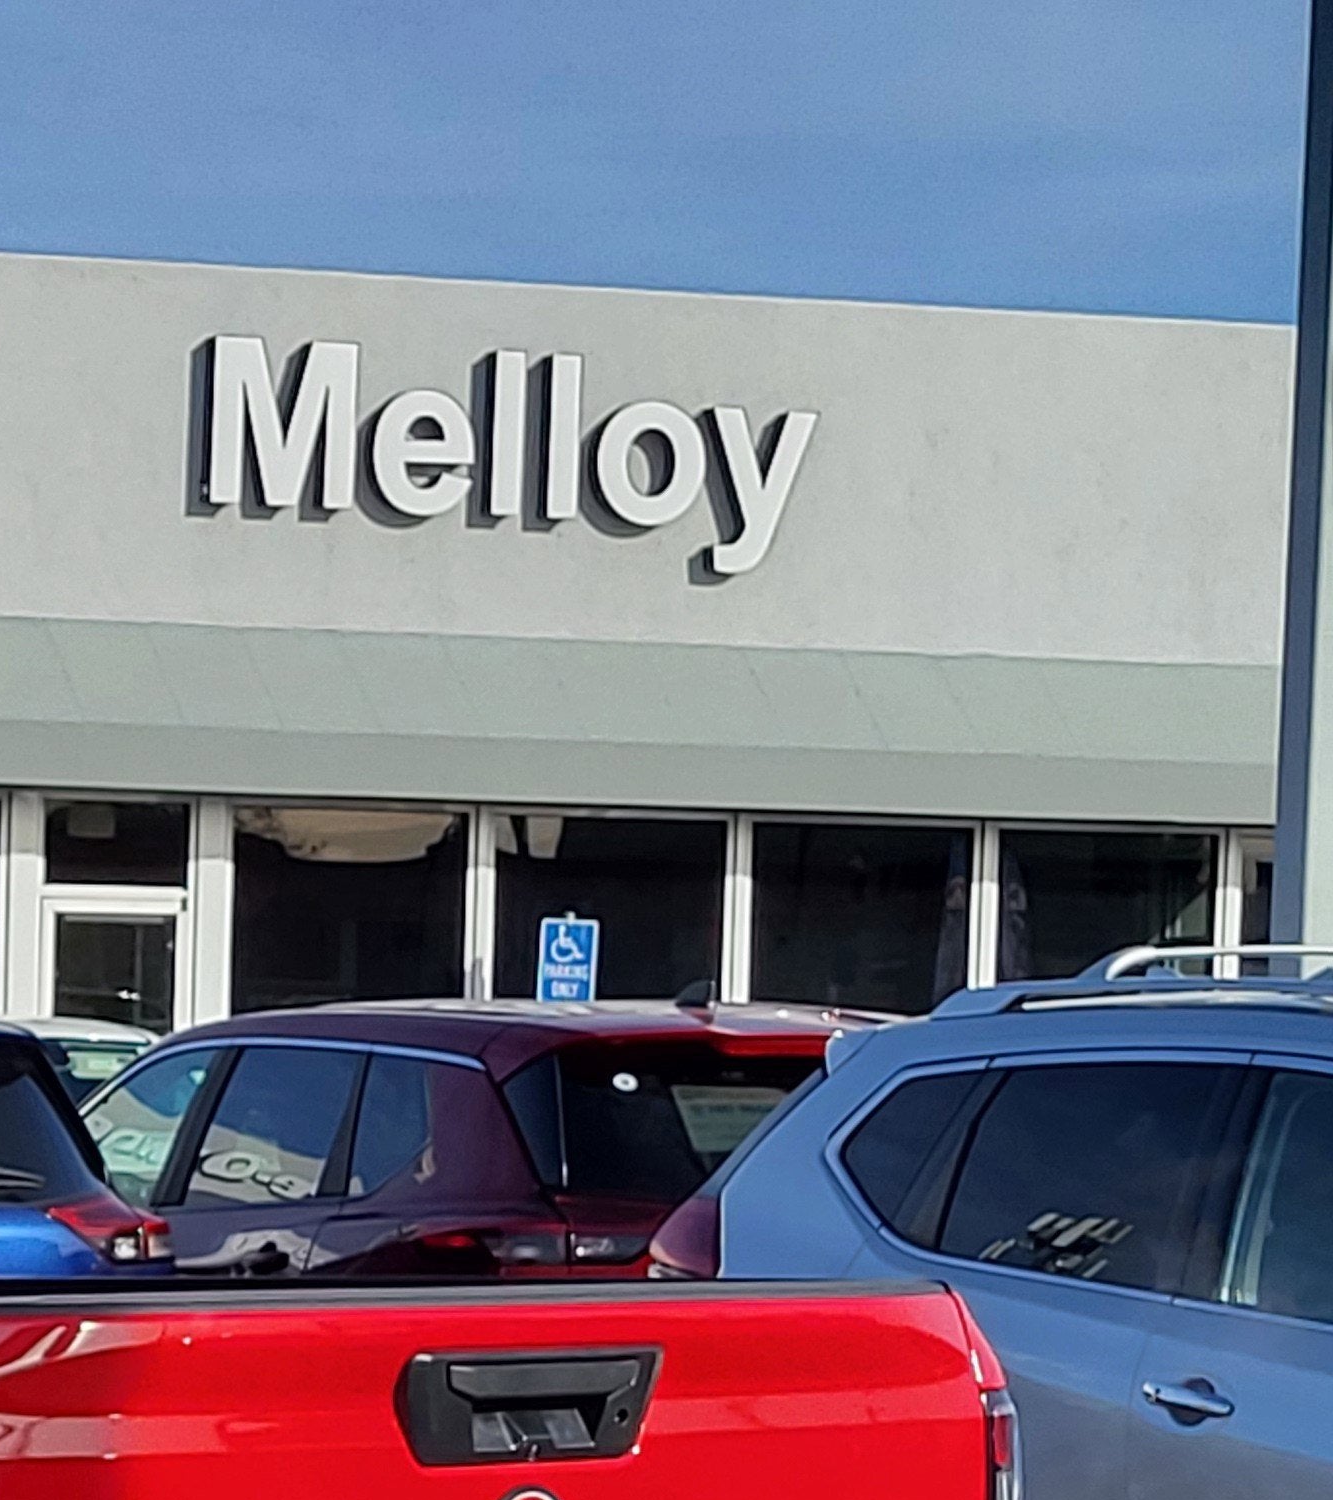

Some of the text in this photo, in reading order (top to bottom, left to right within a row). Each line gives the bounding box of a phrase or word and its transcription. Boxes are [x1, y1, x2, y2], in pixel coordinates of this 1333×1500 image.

[203, 333, 821, 577] Melloy
[543, 961, 589, 982] PARKING
[550, 979, 580, 998] ONLY
